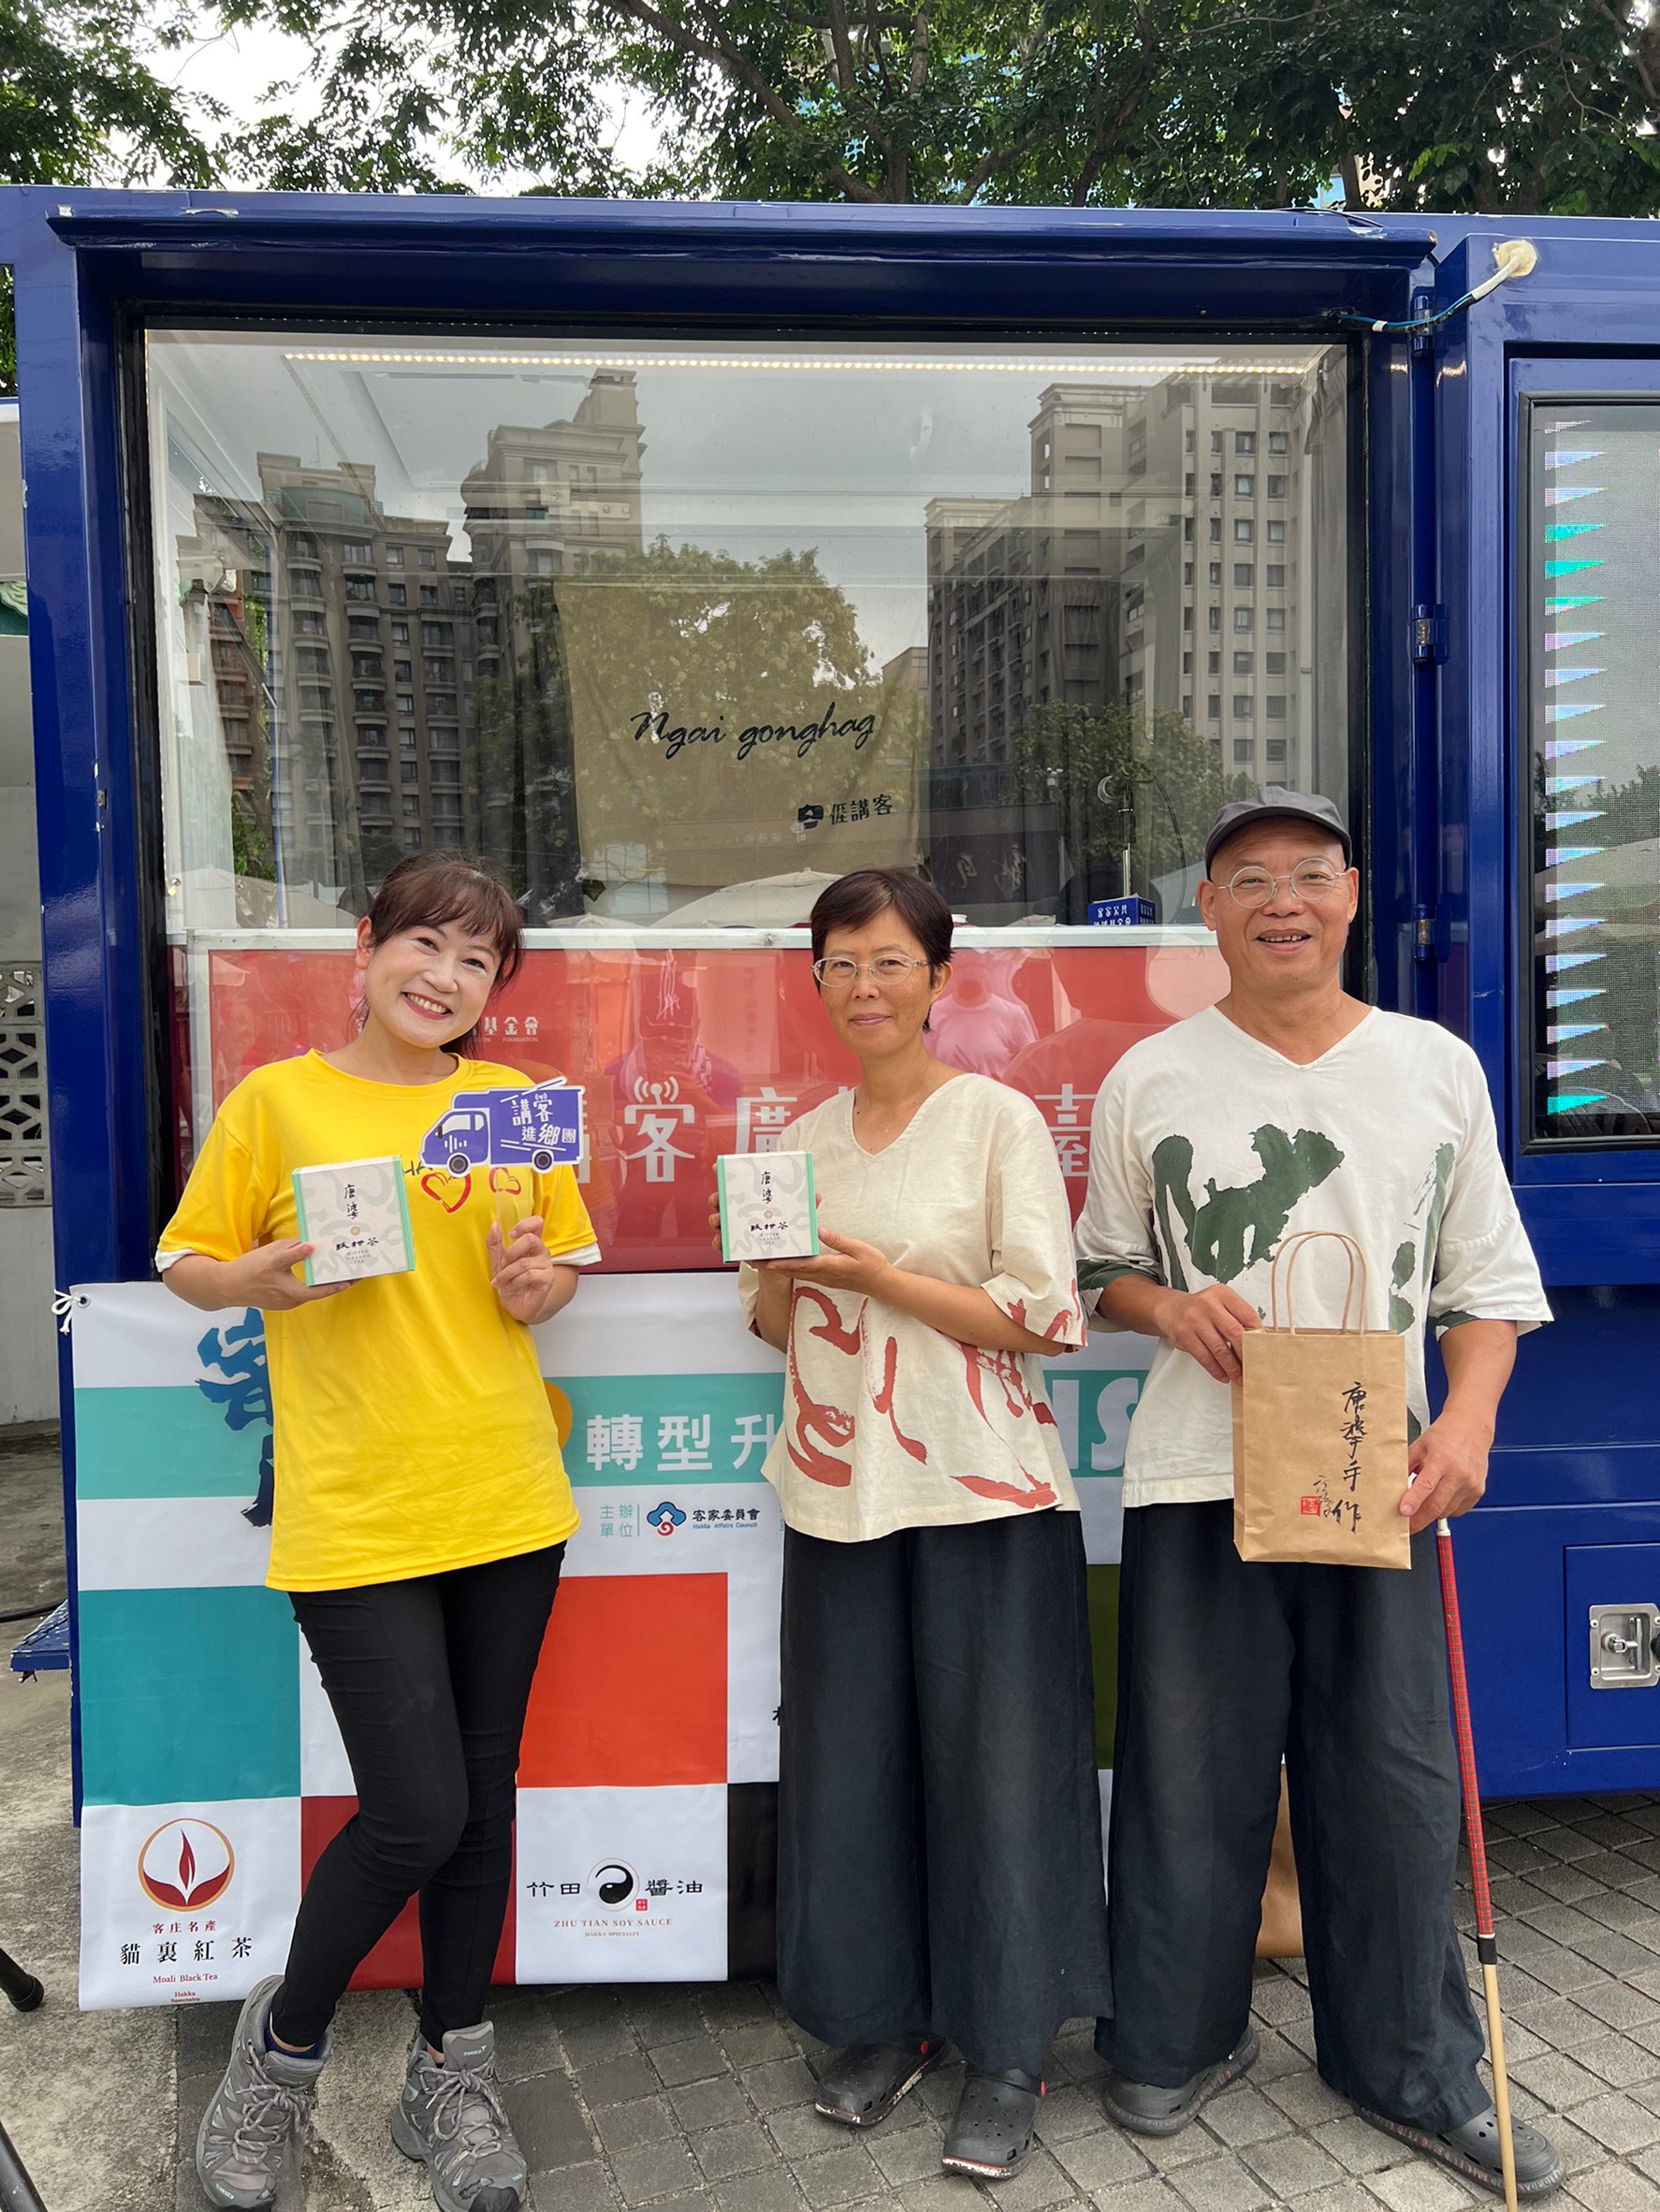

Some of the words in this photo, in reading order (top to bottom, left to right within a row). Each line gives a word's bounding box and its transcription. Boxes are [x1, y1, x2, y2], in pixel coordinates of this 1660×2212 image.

[630, 711, 727, 760] Ngai
[736, 701, 876, 761] gonghag
[472, 1015, 540, 1035] 基金會
[511, 1093, 554, 1127] 講客
[521, 1123, 576, 1147] 進鄉團
[587, 1414, 777, 1472] 轉型升
[692, 1508, 760, 1521] 客家委員會
[526, 1881, 581, 1898] 竹田
[645, 1878, 703, 1897] 醬油
[153, 1919, 216, 1935] 客庄名產
[554, 1919, 577, 1928] ZHU
[581, 1919, 608, 1928] TIAN
[613, 1919, 633, 1928] SOY
[637, 1918, 672, 1927] SAUCE
[120, 1936, 252, 1965] 貓裏紅茶
[153, 1974, 176, 1984] Moali
[180, 1973, 201, 1983] Black
[203, 1972, 218, 1981] Tea
